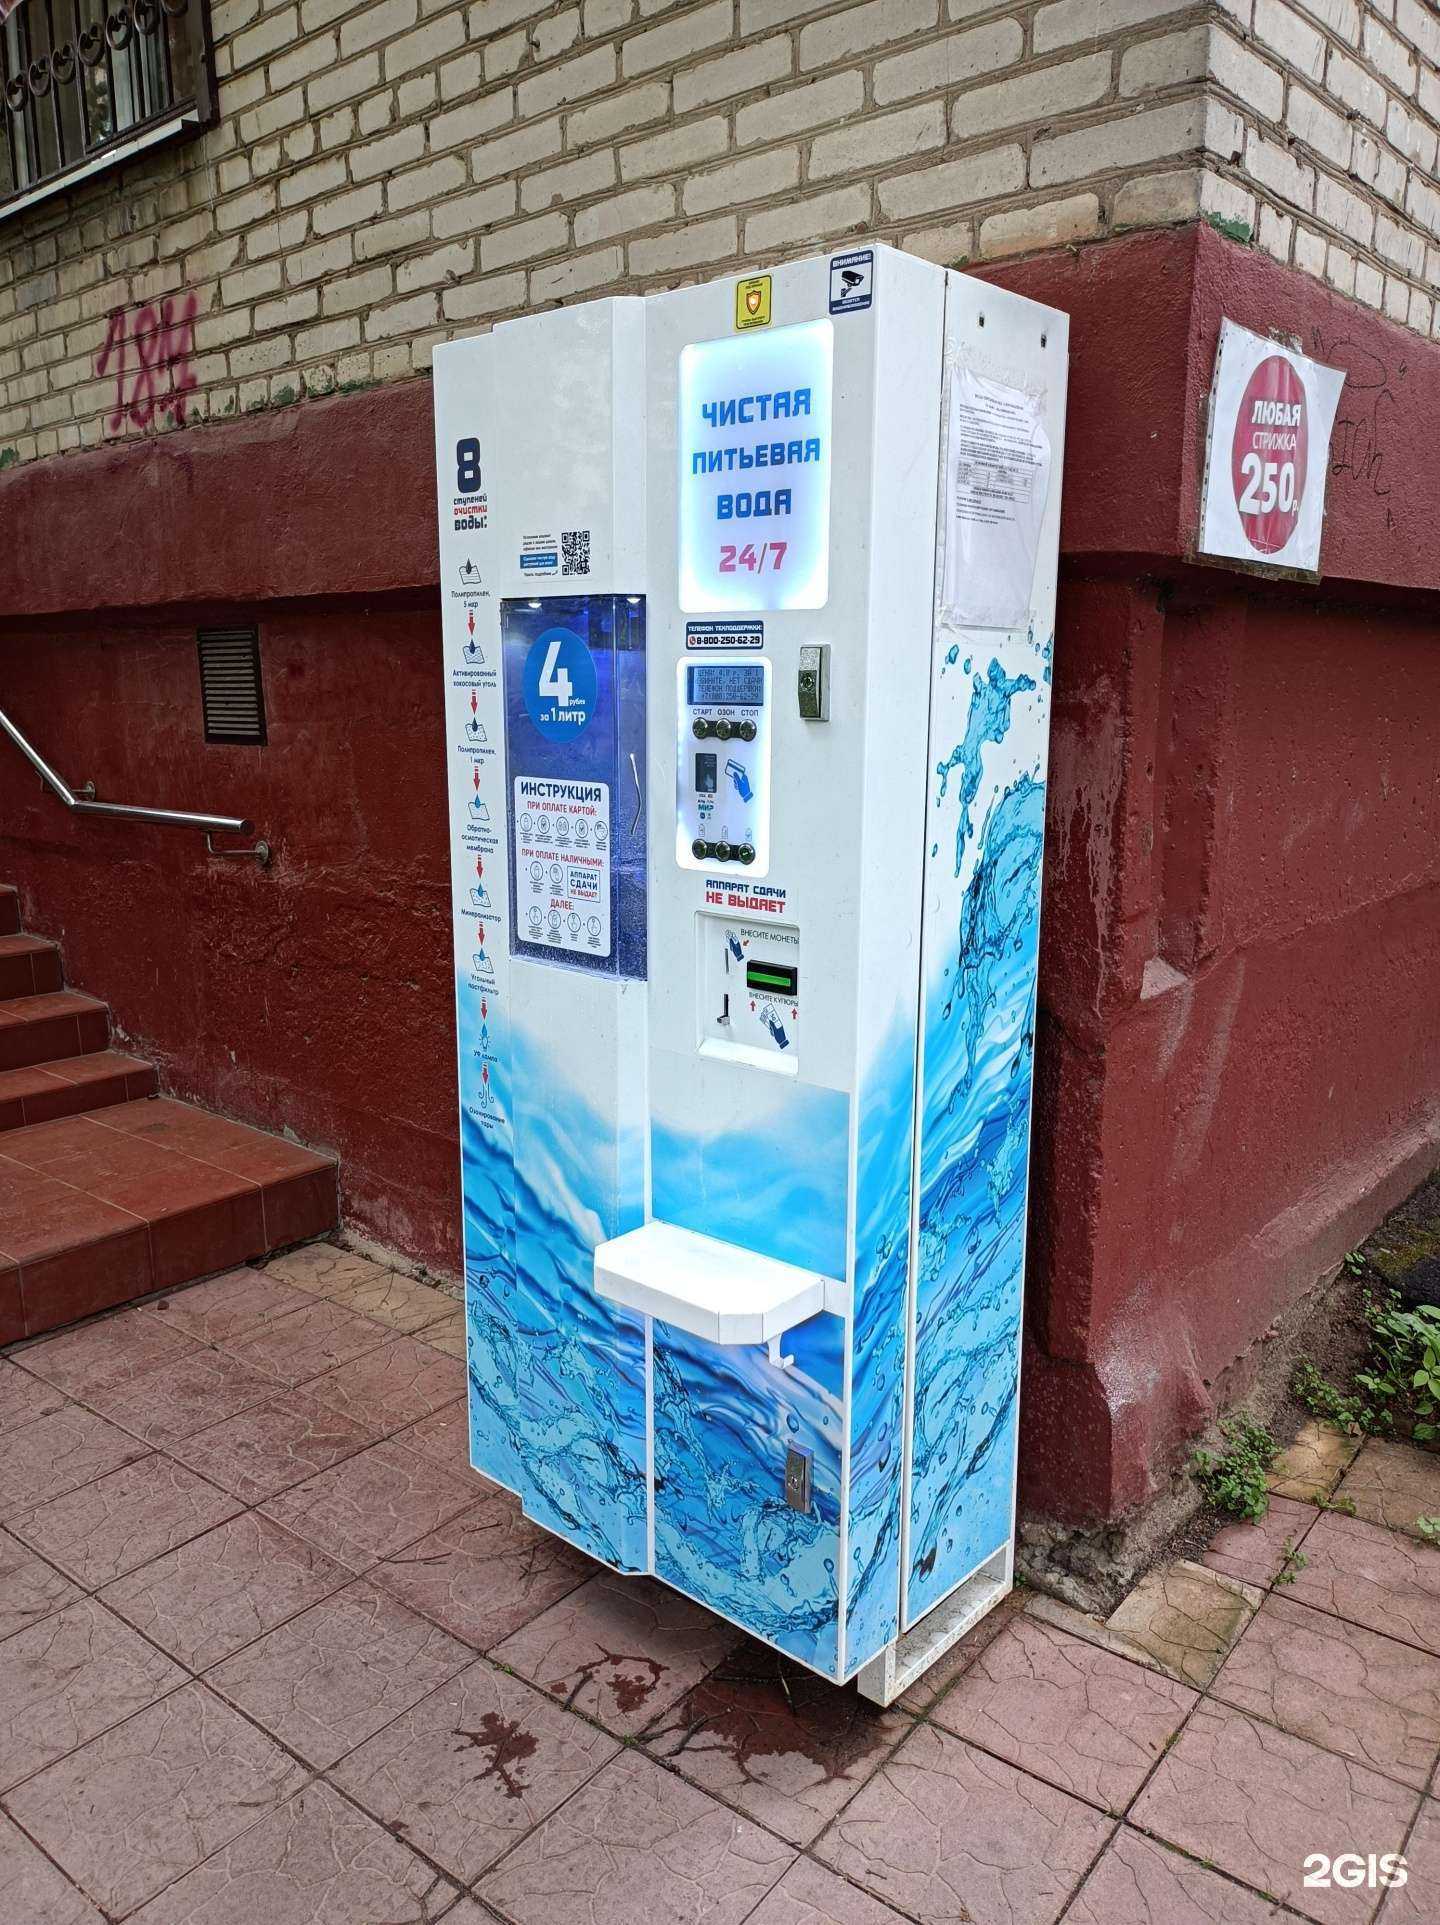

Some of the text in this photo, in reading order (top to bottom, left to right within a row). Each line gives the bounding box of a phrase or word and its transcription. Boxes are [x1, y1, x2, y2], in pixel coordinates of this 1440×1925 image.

[702, 388, 811, 427] ЧИСТАЯ
[1251, 400, 1301, 427] ЛЮБАЯ
[1252, 431, 1297, 450] СТРИЖКА
[456, 437, 481, 493] 8
[692, 438, 820, 475] ПИТЬЕВАЯ
[453, 493, 487, 506] ступеней
[717, 488, 792, 520] ВОДА
[453, 504, 488, 516] очистки
[454, 515, 488, 531] воды:
[719, 542, 788, 574] 24/7
[696, 636, 761, 645] 8-800-250-62-29
[538, 641, 573, 707] 4
[540, 707, 586, 725] за 1 литр
[692, 708, 712, 716] СТАРТ
[717, 708, 735, 716] ОЗОН
[521, 781, 602, 803] ИНСТРУКЦИЯ
[527, 800, 541, 810] ПРИ
[541, 802, 567, 813] ОПЛАТЕ
[521, 848, 534, 858] ПРИ
[535, 850, 559, 861] ОПЛАТЕ
[570, 871, 598, 881] АППАРАТ
[570, 879, 598, 890] СДАЧИ
[705, 879, 787, 898] АППАРАТ СДАЧИ
[705, 891, 786, 914] НЕ ВЫДАЕТ
[740, 928, 800, 945] ВНЕСИТЕ МОНЕТЫ
